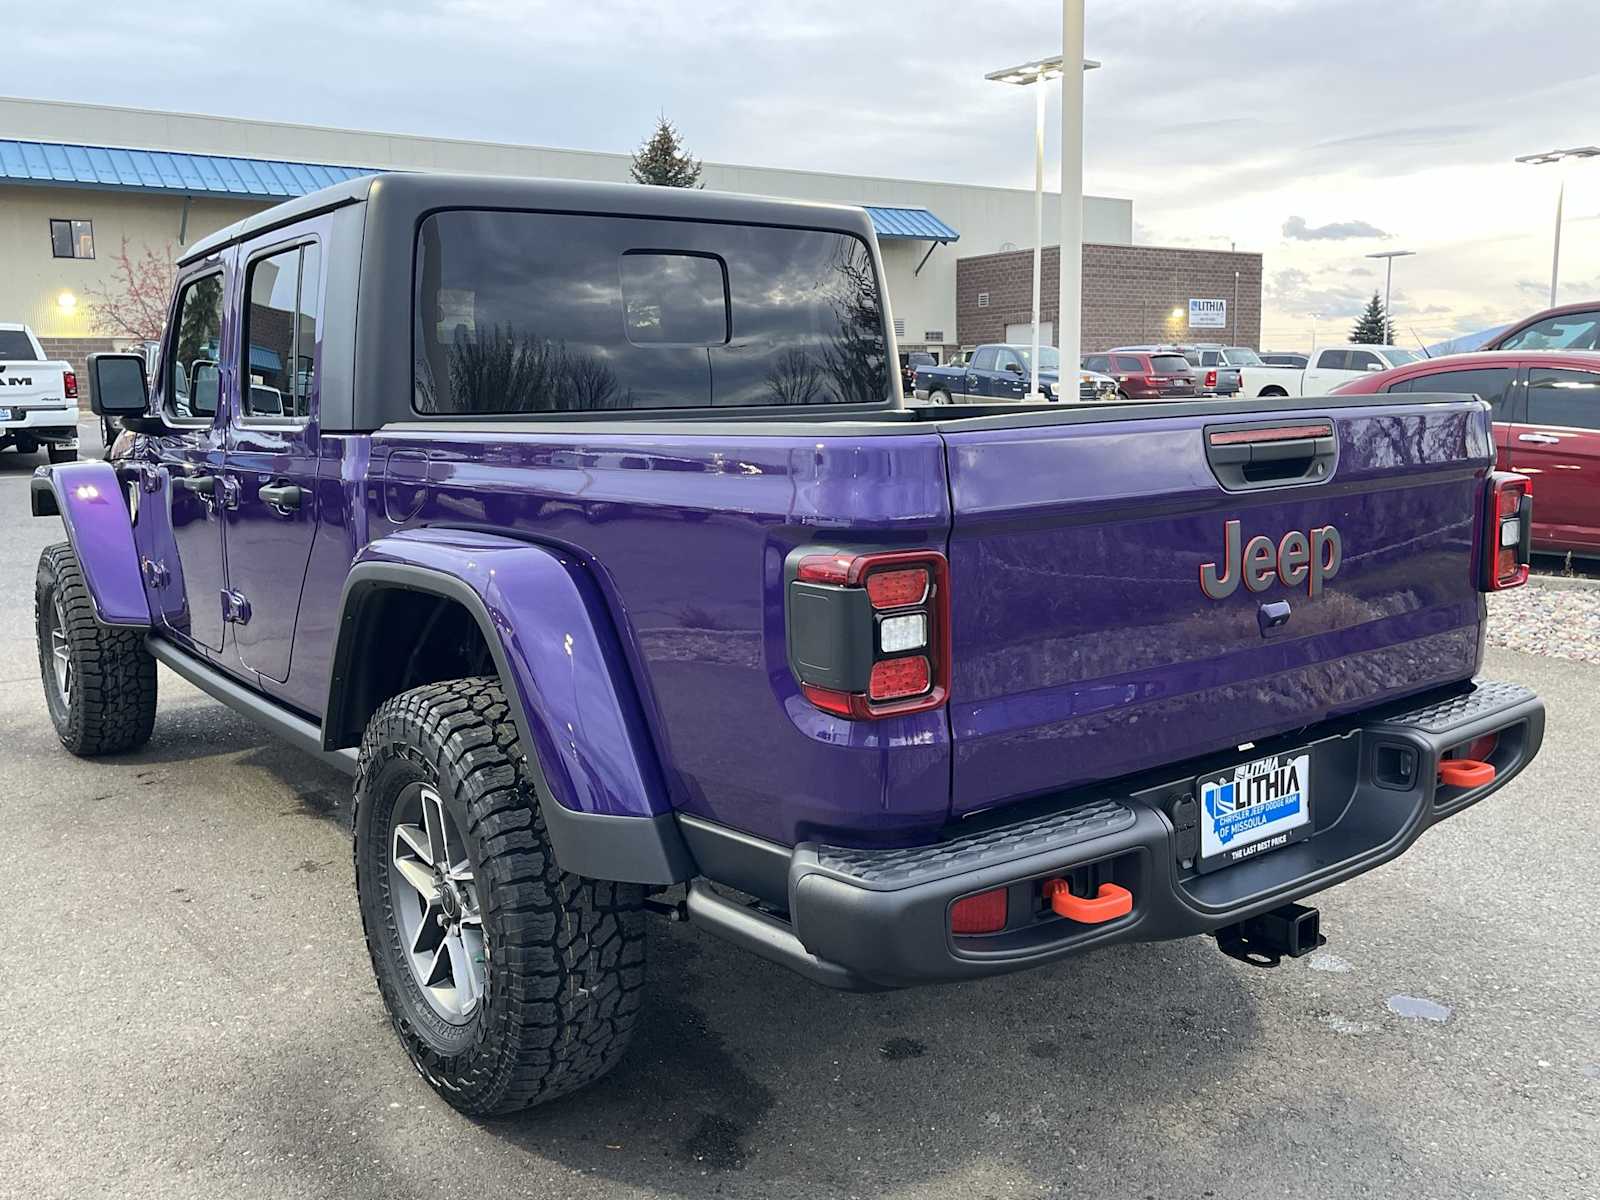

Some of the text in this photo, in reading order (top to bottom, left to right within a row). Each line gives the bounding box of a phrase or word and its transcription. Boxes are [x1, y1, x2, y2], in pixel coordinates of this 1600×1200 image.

[1199, 301, 1224, 311] LITHIA
[1200, 520, 1342, 600] Jeep
[1245, 756, 1279, 777] LITHIA
[1236, 766, 1299, 810] LITHIA
[1220, 795, 1297, 826] CHRYSLER JEEP DODGE RAM
[1220, 814, 1267, 838] OF MISSOULA
[1232, 835, 1287, 860] THE LAST BEST PRICE
